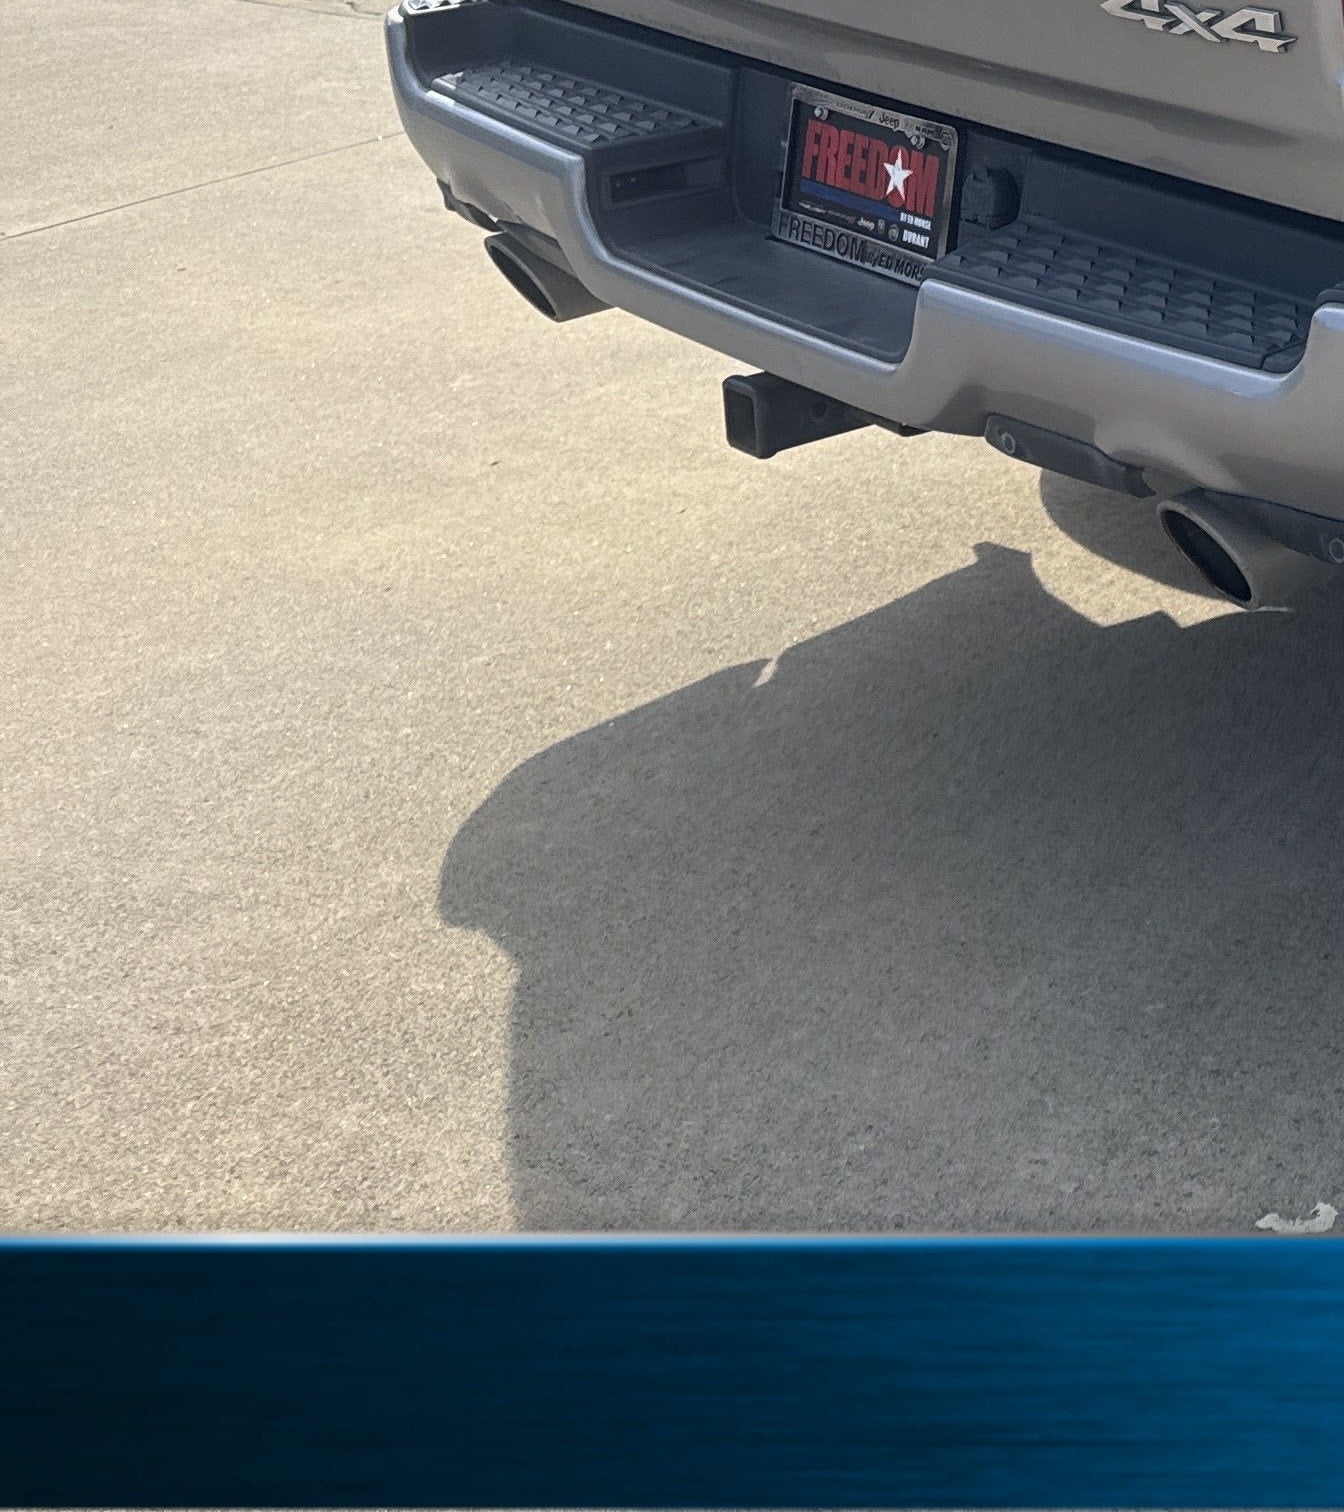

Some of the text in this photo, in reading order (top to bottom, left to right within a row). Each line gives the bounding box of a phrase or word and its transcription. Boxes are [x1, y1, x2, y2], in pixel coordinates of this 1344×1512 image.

[879, 111, 900, 130] Jeep
[801, 119, 940, 217] FREEDOM
[779, 215, 865, 260] FREEDOM
[878, 252, 893, 271] ED
[902, 229, 930, 248] DURANT
